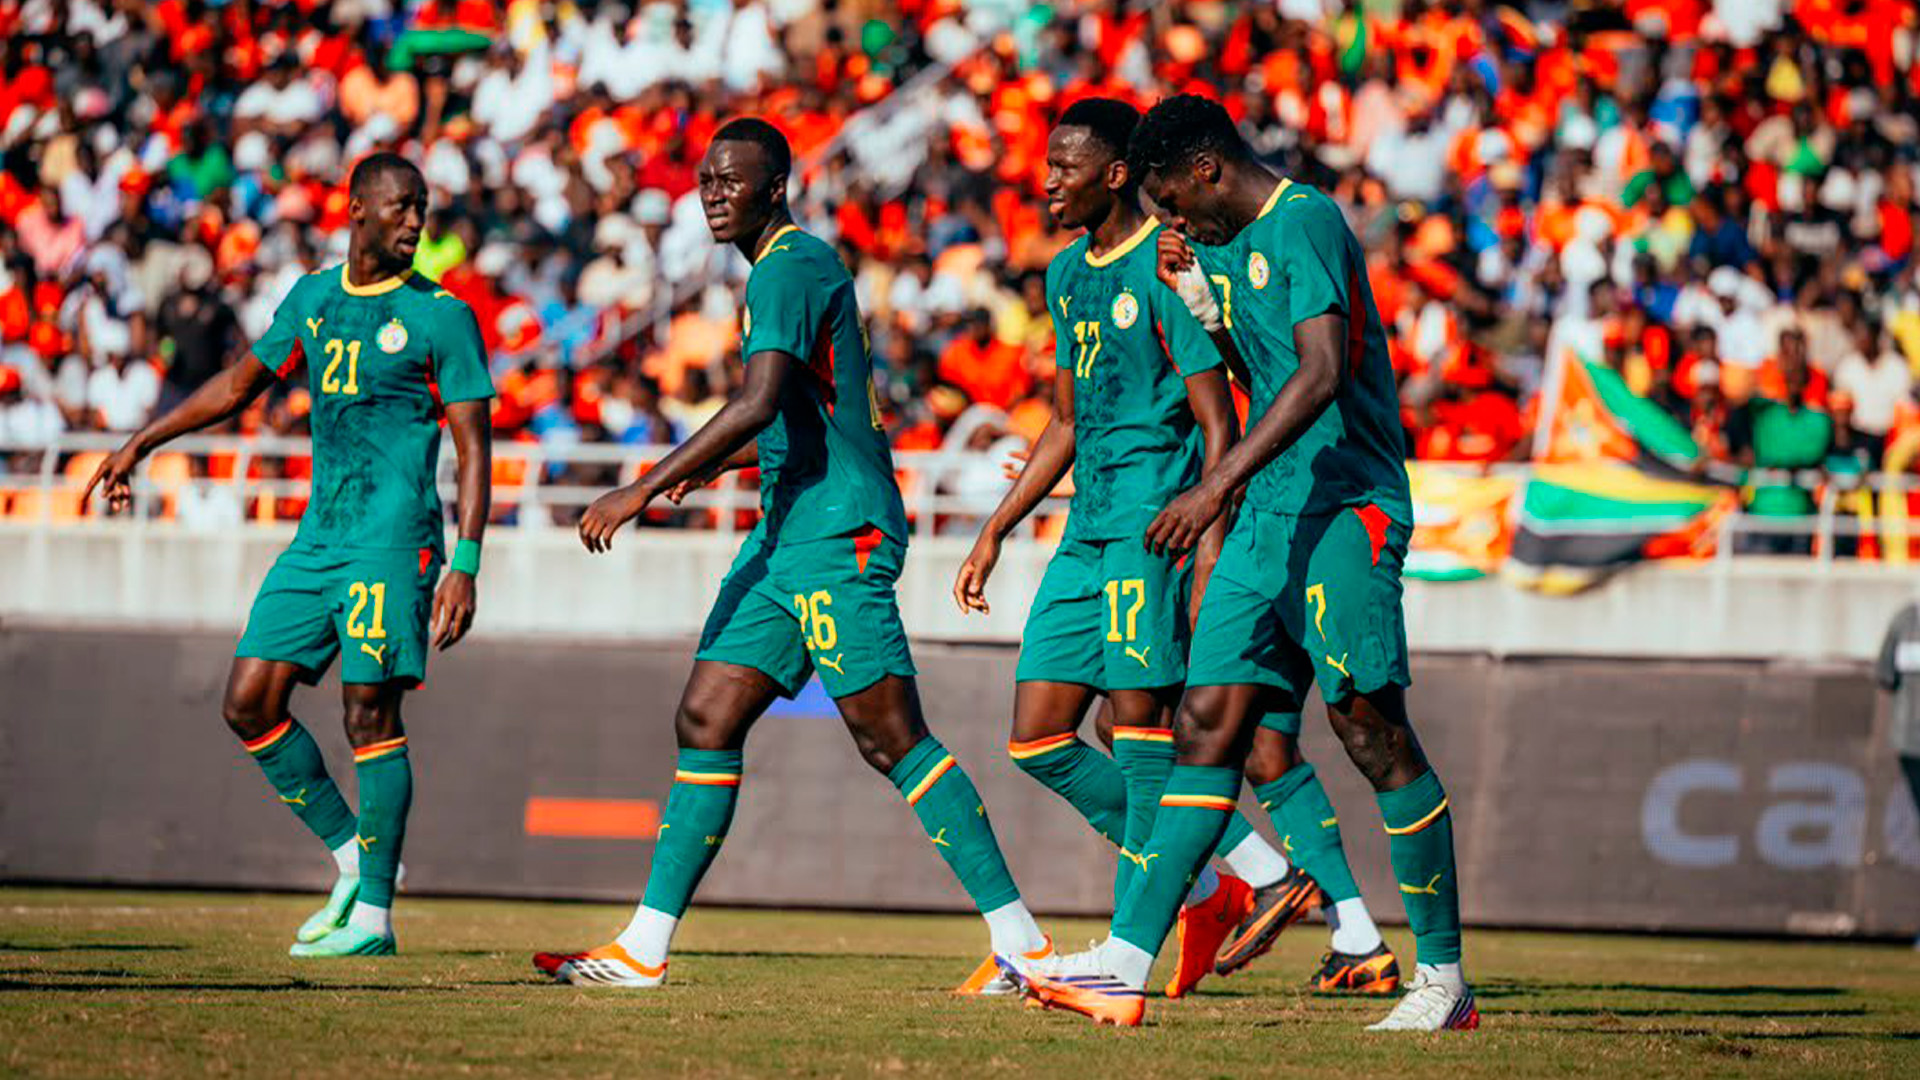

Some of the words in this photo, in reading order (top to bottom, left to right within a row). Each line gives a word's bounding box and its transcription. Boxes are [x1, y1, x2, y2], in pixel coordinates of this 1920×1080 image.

[322, 339, 362, 395] 21
[1073, 321, 1102, 379] 17
[346, 581, 387, 639] 21
[794, 590, 837, 650] 26
[1104, 579, 1146, 642] 17
[1306, 583, 1326, 642] 7
[1641, 758, 1920, 866] ca
